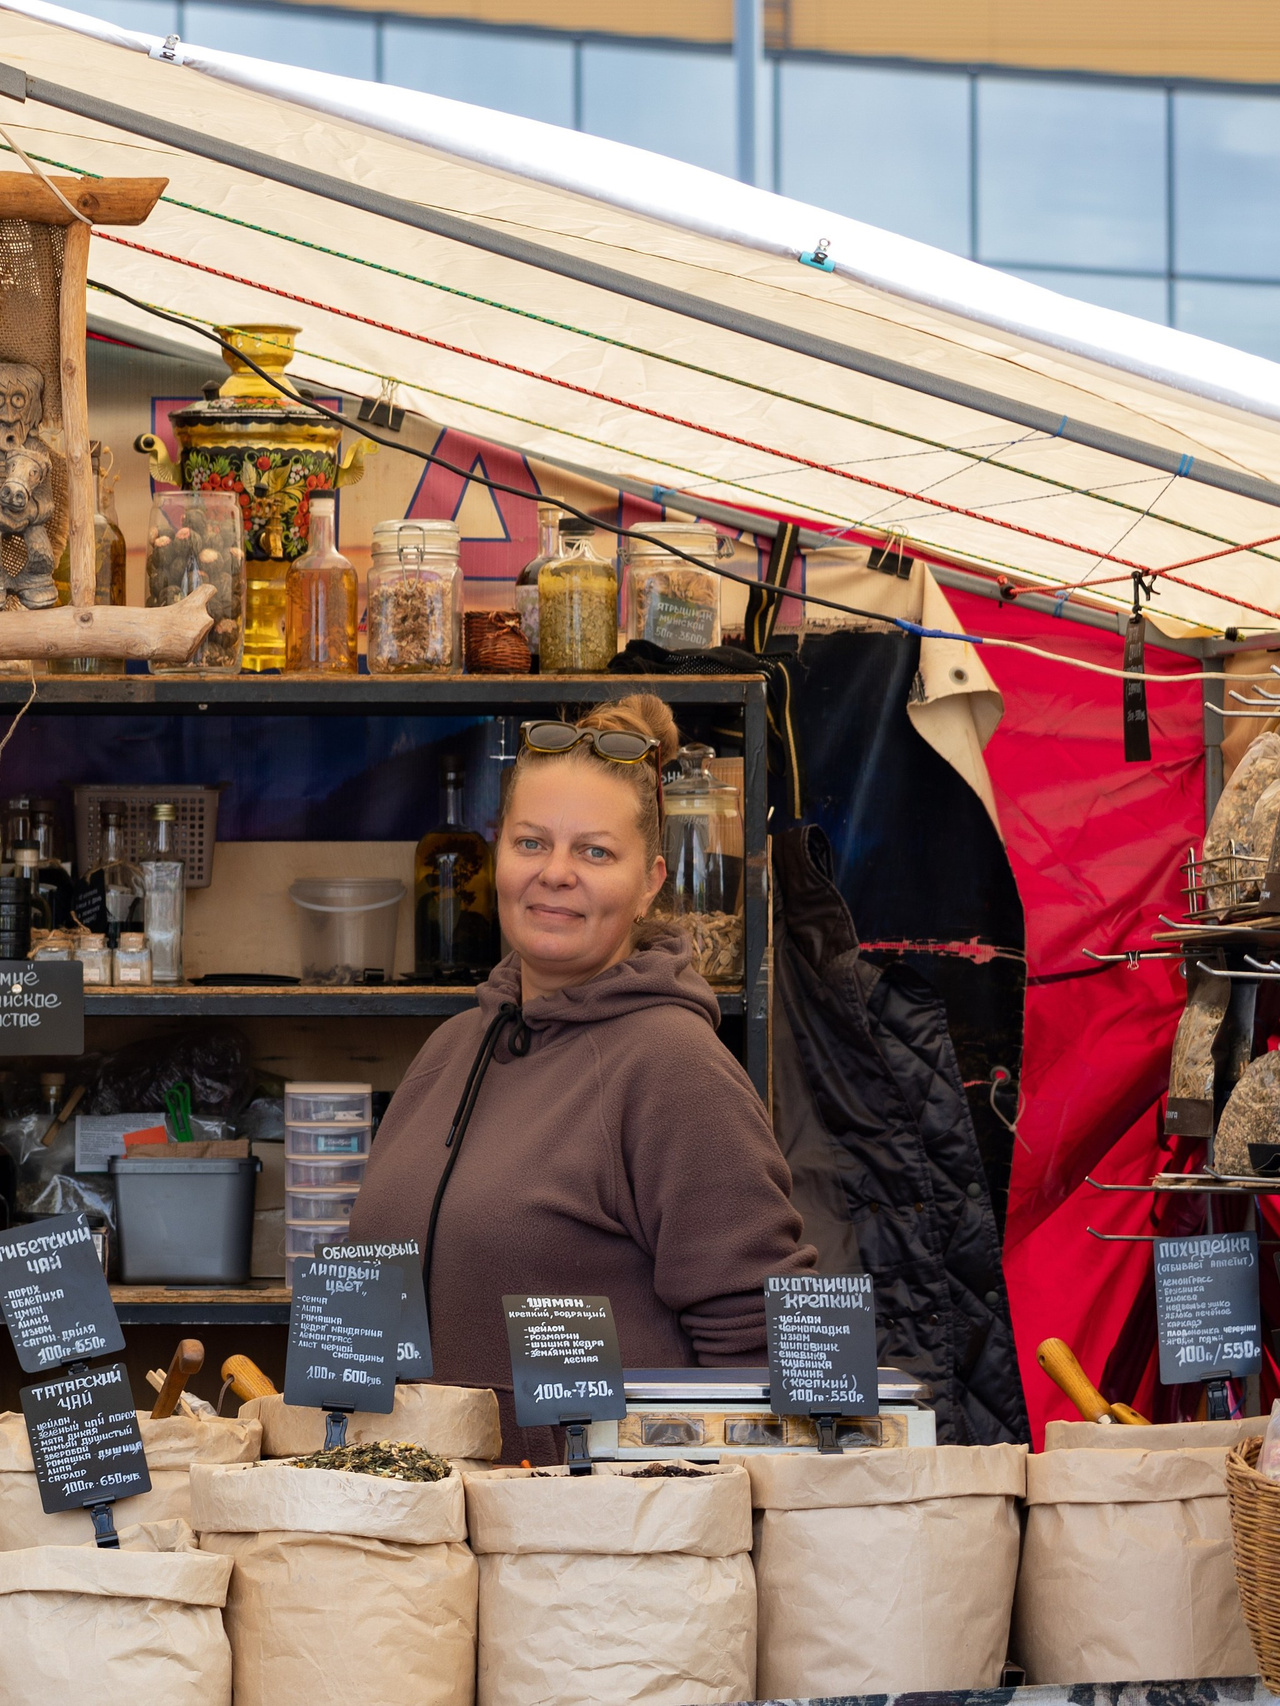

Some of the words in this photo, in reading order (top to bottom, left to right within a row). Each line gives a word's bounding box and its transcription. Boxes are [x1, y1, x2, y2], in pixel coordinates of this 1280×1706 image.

[322, 1239, 420, 1260] ОБЛЕПИХОВЫЙ
[1159, 1234, 1250, 1261] ПОХУДЕЙКА
[26, 1251, 62, 1274] ЧАЙ
[1210, 1253, 1254, 1268] АППЕТИТ)
[7, 1284, 41, 1300] ПОРОХ
[1164, 1285, 1204, 1295] БРУСНИКА
[11, 1289, 65, 1309] ОБЛЕПИХА
[301, 1295, 328, 1305] СЕНЧА
[302, 1305, 322, 1313] ЛИПА
[1165, 1311, 1193, 1320] ЯБЛОКО
[18, 1315, 49, 1329] ЛИЛИЯ
[301, 1313, 342, 1325] РОМАШКА
[778, 1312, 821, 1325] ЦЕЙЛОН
[21, 1325, 52, 1338] ИЗЮМ
[331, 1326, 383, 1338] МАНДАРИНА
[528, 1321, 565, 1334] ЦЕЙЛОН
[778, 1324, 850, 1337] ЧЕРНОПЛОДКА
[299, 1332, 353, 1344] ЛЕМОНГРАСС
[530, 1333, 579, 1341] РОЗМАРИН
[780, 1333, 810, 1341] ИЗЮМ
[298, 1340, 318, 1349] ЛИСТ
[573, 1340, 604, 1350] КЕДРА
[779, 1342, 840, 1352] ШИПОВНИК
[332, 1351, 384, 1364] СМОРОДИНЫ
[531, 1348, 585, 1358] ЗЕМЛЯНИКА
[779, 1350, 826, 1360] ЕЖЕВИКА
[564, 1356, 599, 1364] ЛЕСНАЯ
[780, 1359, 832, 1369] КЛУБНИКА
[782, 1368, 823, 1378] МАЛИНА
[32, 1364, 122, 1401] ТАТАРСКИЙ
[57, 1390, 93, 1411] ЧАЙ
[36, 1417, 70, 1431] ЦЕЙЛОН
[38, 1421, 79, 1439] ЗЕЛЁНЫЙ
[84, 1412, 104, 1428] ЧАЙ
[108, 1410, 136, 1423] ПОРОХ
[40, 1440, 77, 1454] ТИМЬЯН
[81, 1425, 132, 1446] ДУШИСТЫЙ
[41, 1435, 63, 1447] МЯТА
[67, 1428, 98, 1442] ДИКАЯ
[44, 1446, 89, 1461] ЗВЕРОБОЙ
[46, 1453, 91, 1468] РОМАШКА
[47, 1464, 72, 1475] ЛИПА
[48, 1469, 87, 1483] САФЛОР
